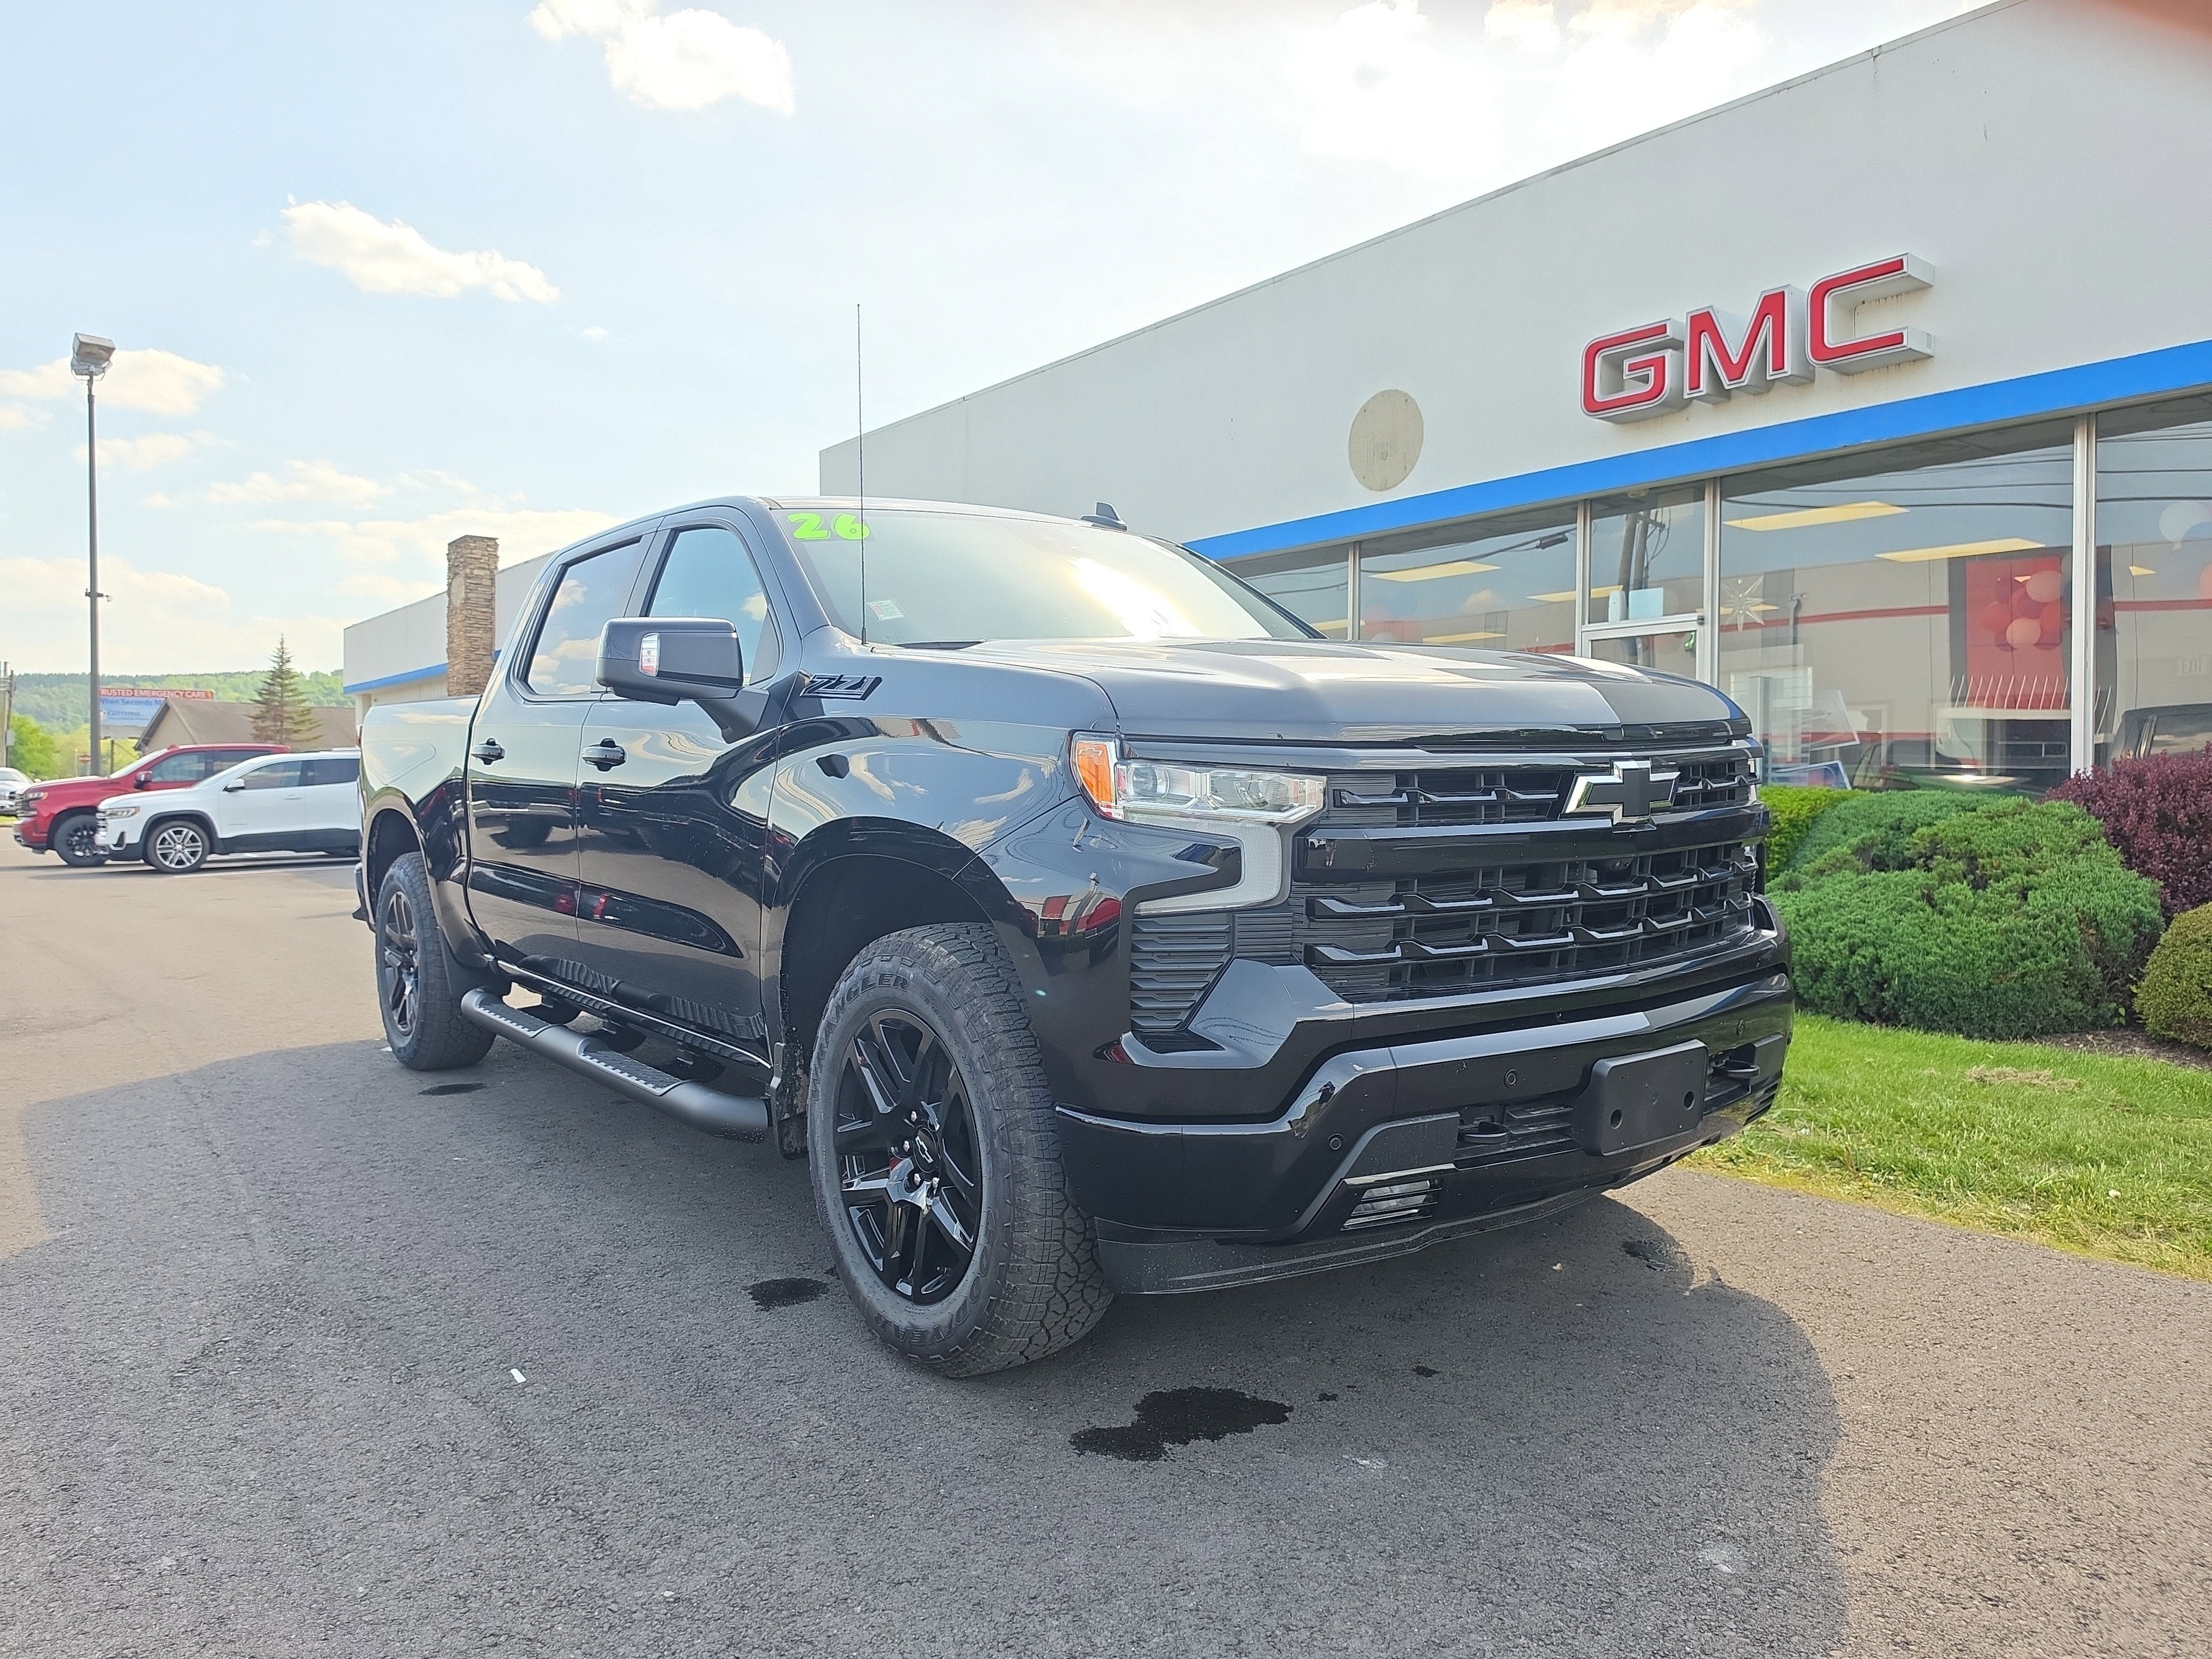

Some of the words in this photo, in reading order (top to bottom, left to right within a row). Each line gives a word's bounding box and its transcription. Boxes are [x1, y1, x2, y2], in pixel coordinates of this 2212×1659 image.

[1581, 252, 1911, 419] GMC
[788, 513, 870, 540] 26
[800, 674, 880, 699] Z71
[809, 972, 910, 1101] WRANGLER
[873, 1208, 995, 1346] GOODYEAR
